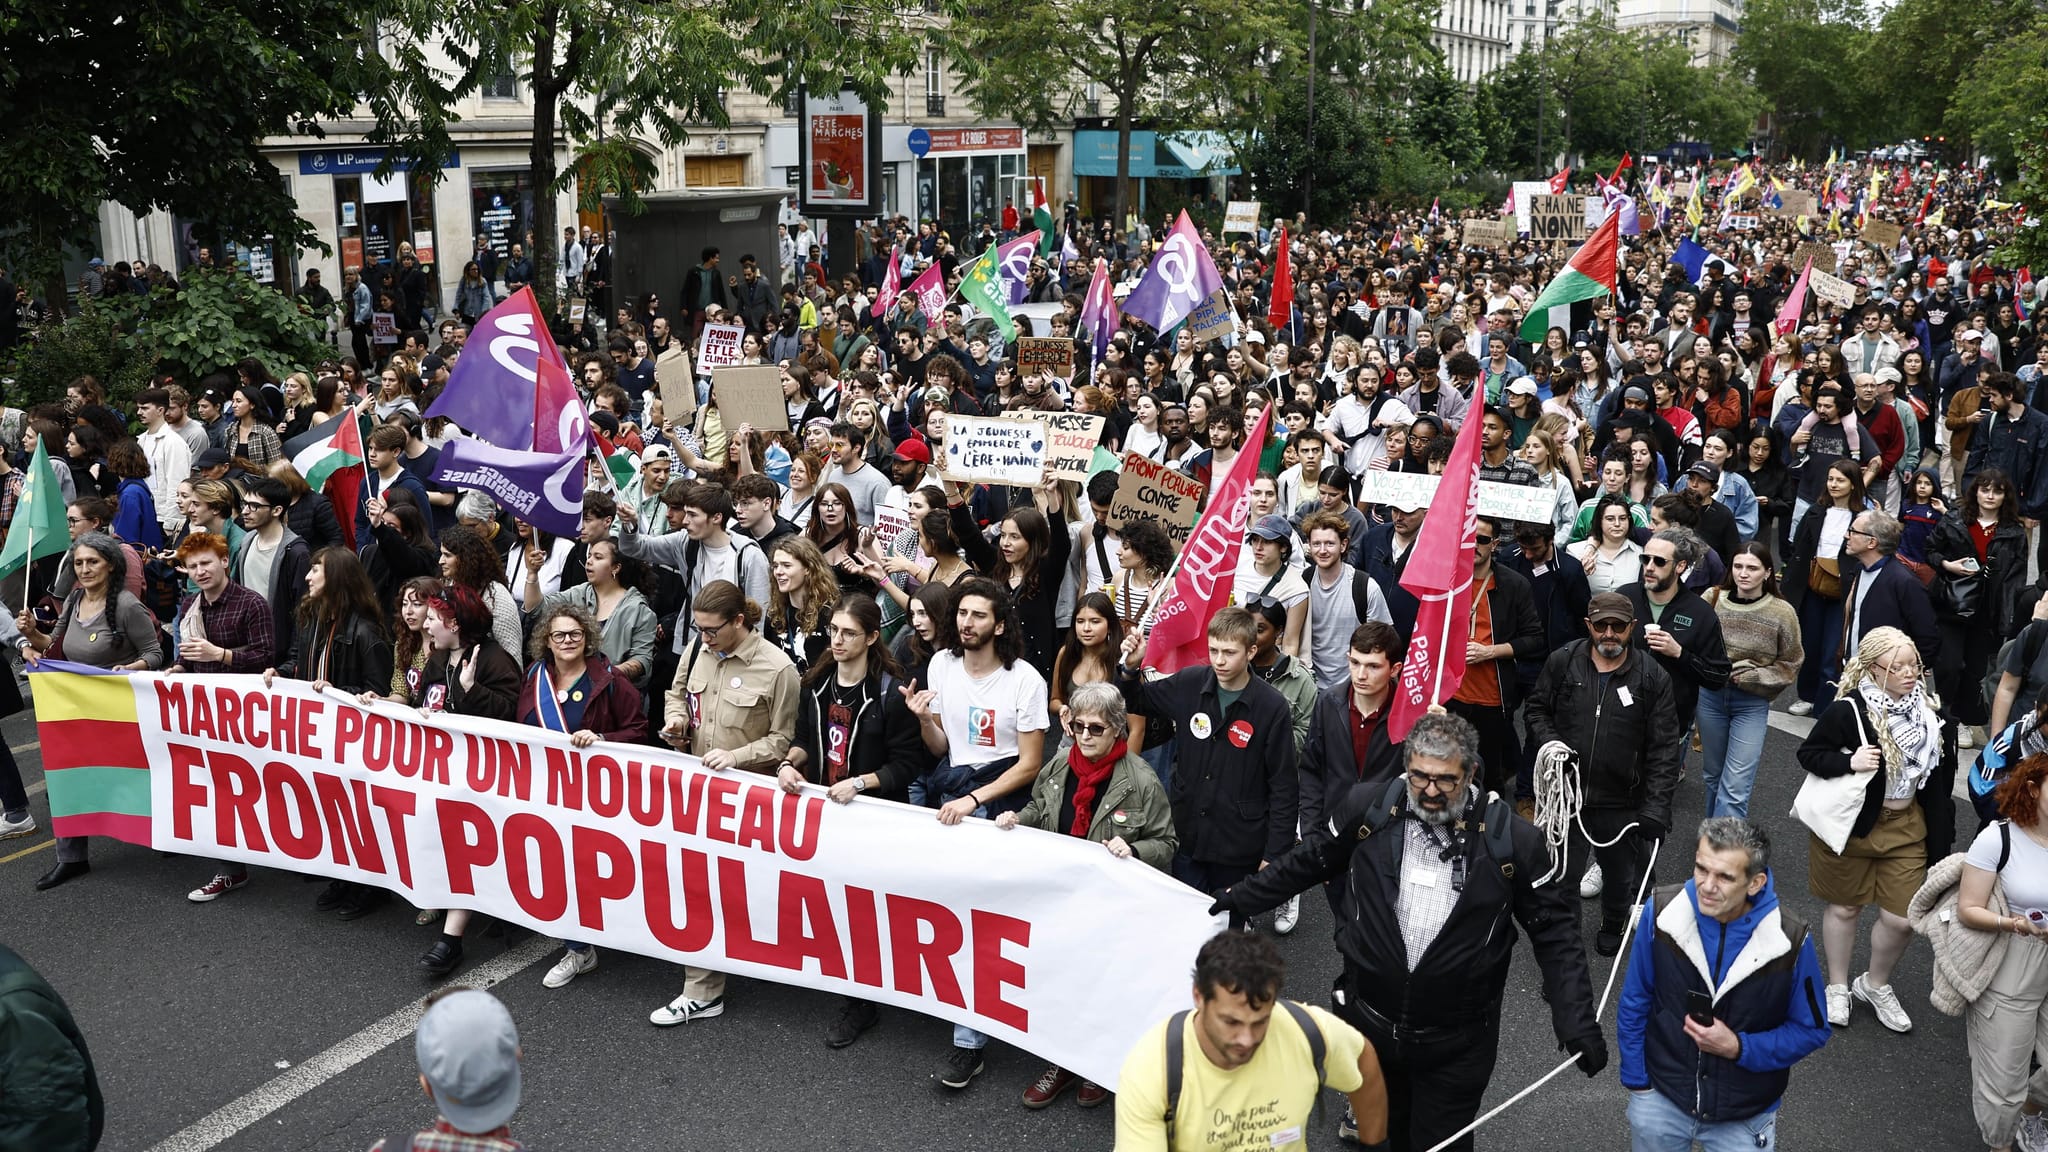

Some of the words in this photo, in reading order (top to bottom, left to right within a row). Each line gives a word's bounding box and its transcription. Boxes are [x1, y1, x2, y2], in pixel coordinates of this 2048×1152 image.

[812, 115, 837, 129] FÊTE
[337, 153, 354, 166] LIP
[1531, 216, 1585, 239] NON!!
[1195, 307, 1216, 321] PIPI
[708, 329, 738, 341] POUR
[705, 343, 720, 355] ET
[721, 345, 736, 357] LE
[1020, 340, 1031, 349] LA
[1032, 340, 1069, 351] JEUNESSE
[1023, 349, 1068, 363] EMMERDE
[953, 425, 968, 436] LA
[976, 427, 1032, 439] JEUNESSE
[966, 438, 1021, 449] EMMERDE
[1123, 453, 1163, 481] FRONT
[1373, 470, 1405, 490] VOUS
[1137, 485, 1182, 514] CONTRE
[1480, 497, 1520, 512] BORDEL
[879, 514, 895, 524] POUR
[878, 522, 904, 536] POUV
[1675, 615, 1691, 627] NIKE
[153, 680, 324, 760] MARCHE
[334, 705, 454, 786] POUR
[463, 733, 533, 802] UN
[543, 746, 826, 861] NOUVEAU
[167, 742, 417, 890] FRONT
[436, 798, 1032, 1034] POPULAIRE
[1213, 1107, 1232, 1127] On
